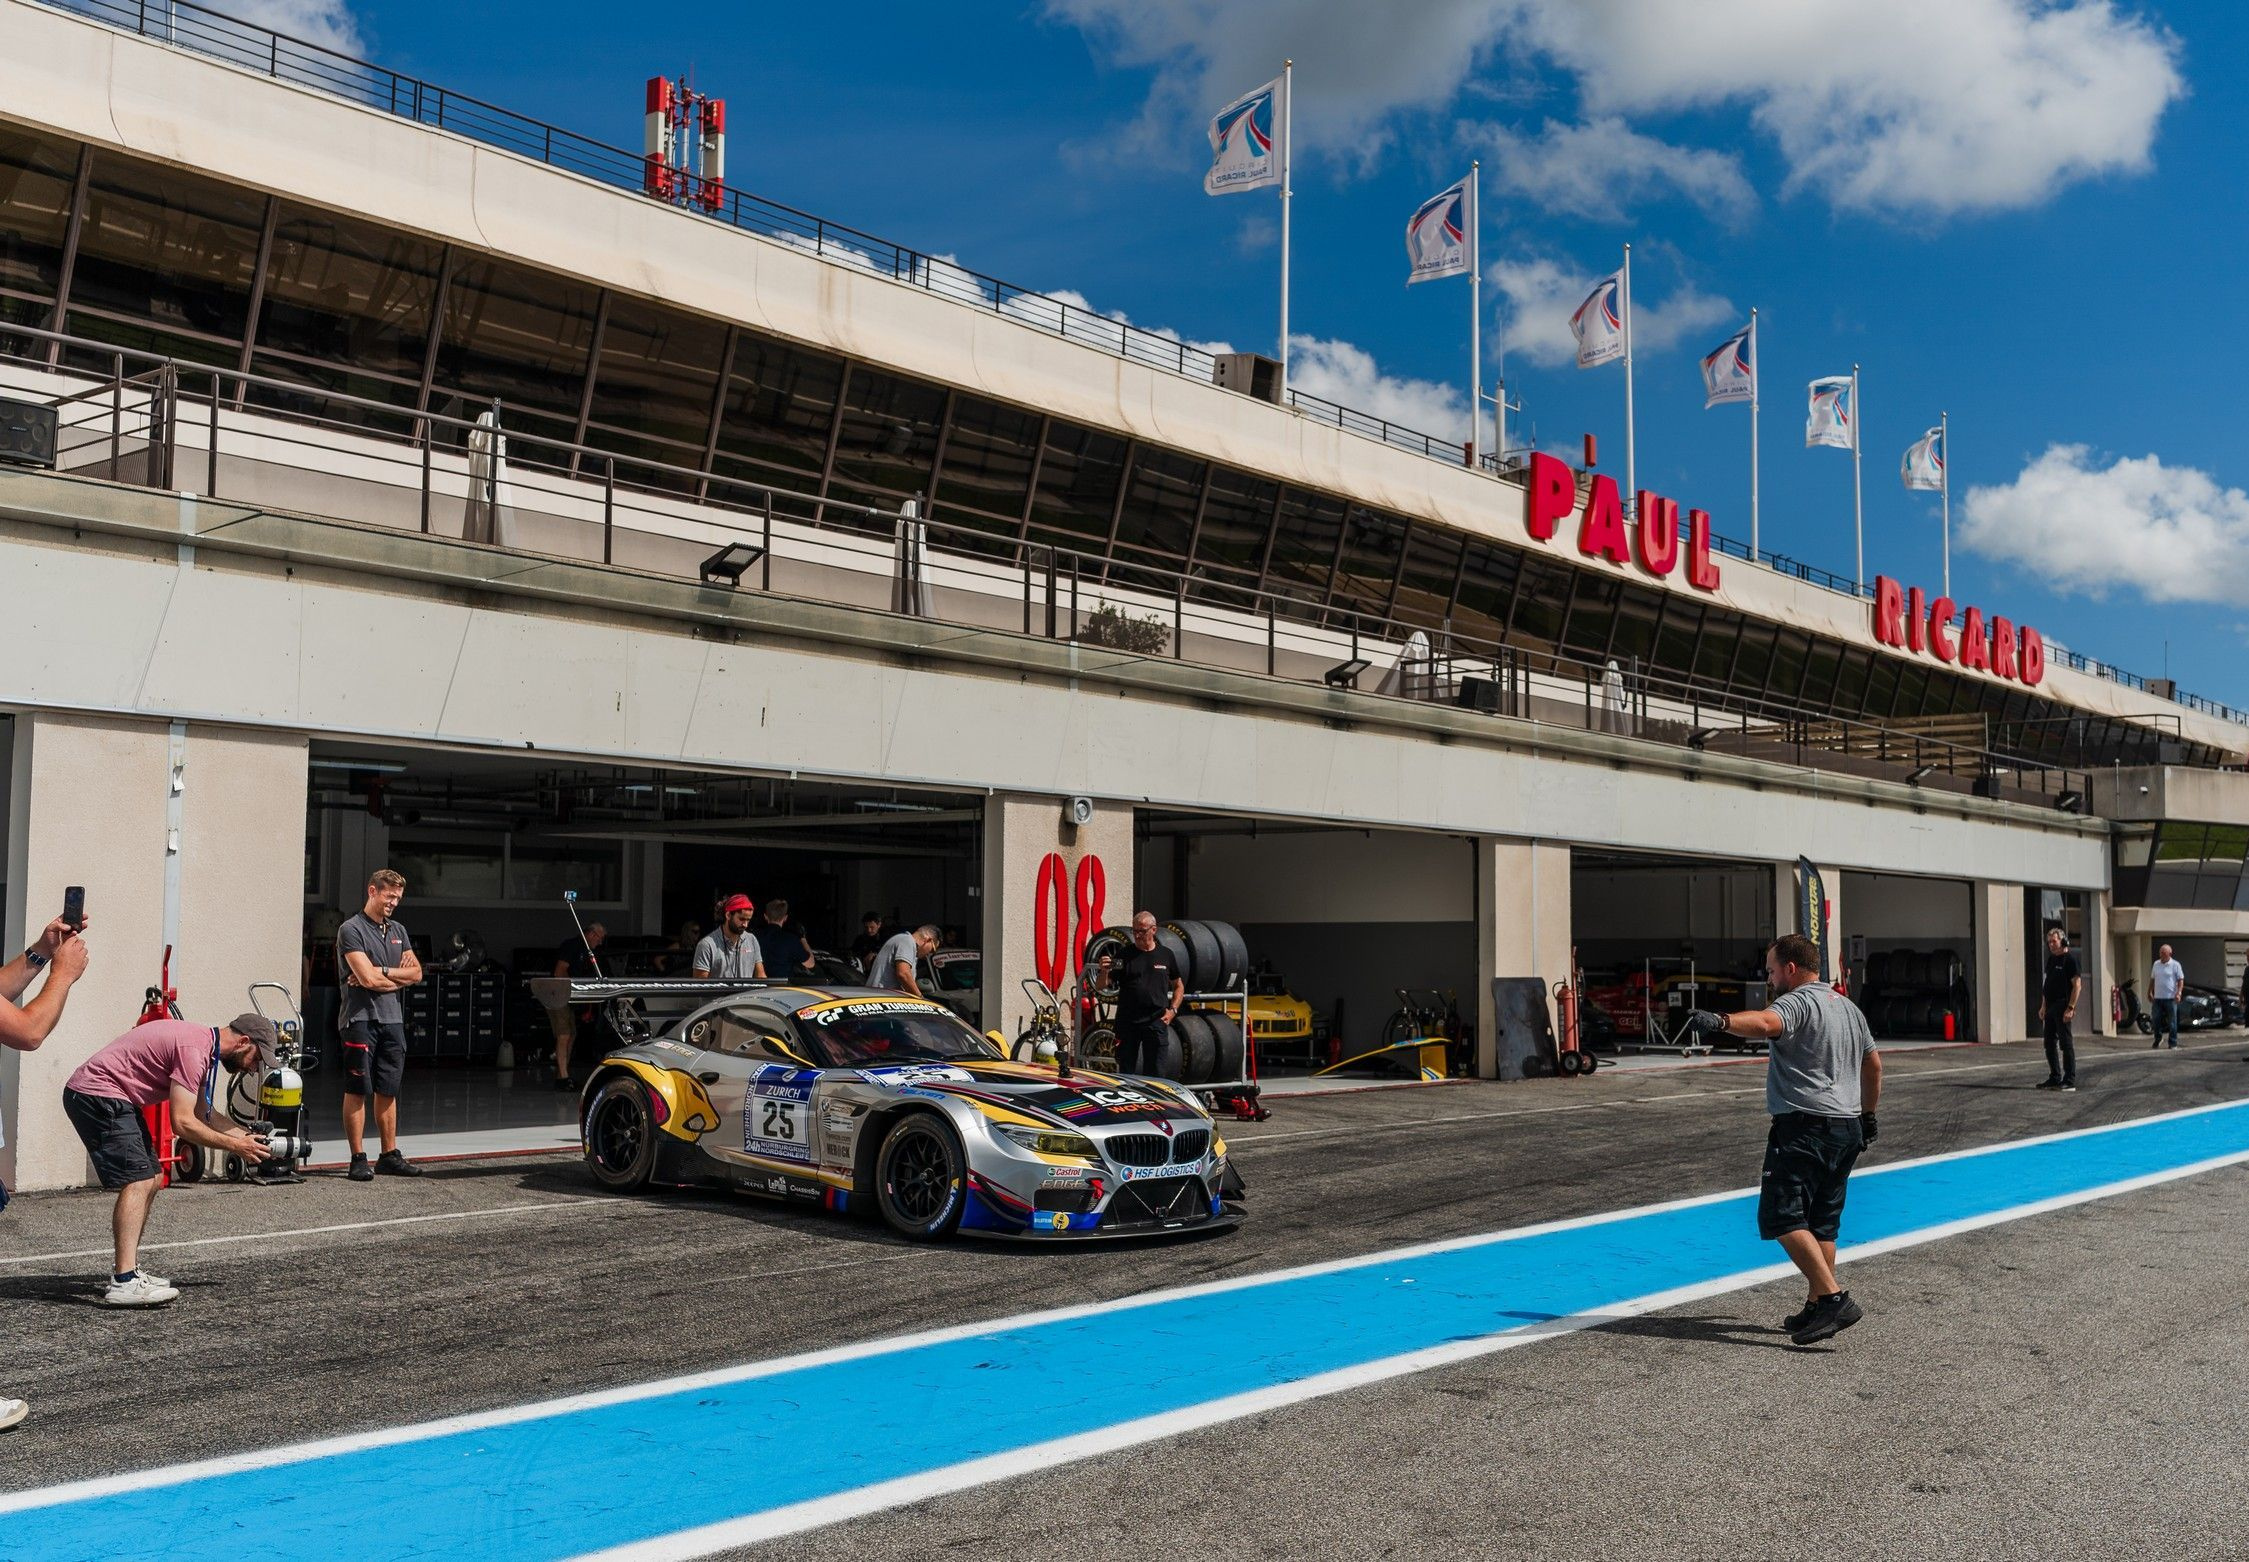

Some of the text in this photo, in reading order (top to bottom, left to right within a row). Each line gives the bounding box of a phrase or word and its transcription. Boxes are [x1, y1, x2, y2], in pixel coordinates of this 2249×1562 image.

[1529, 452, 2045, 687] PAUL RICARD
[1034, 851, 1106, 994] 08
[848, 1003, 882, 1014] GRAN
[883, 1002, 934, 1012] TURISMO
[766, 1085, 801, 1099] ZURICH
[763, 1100, 795, 1140] 25
[745, 1139, 761, 1153] 24h
[1055, 1168, 1082, 1176] Castrol
[1134, 1163, 1195, 1178] HSF LOGISTICS
[1040, 1179, 1085, 1190] EDGE
[930, 1194, 955, 1231] MICHELIN
